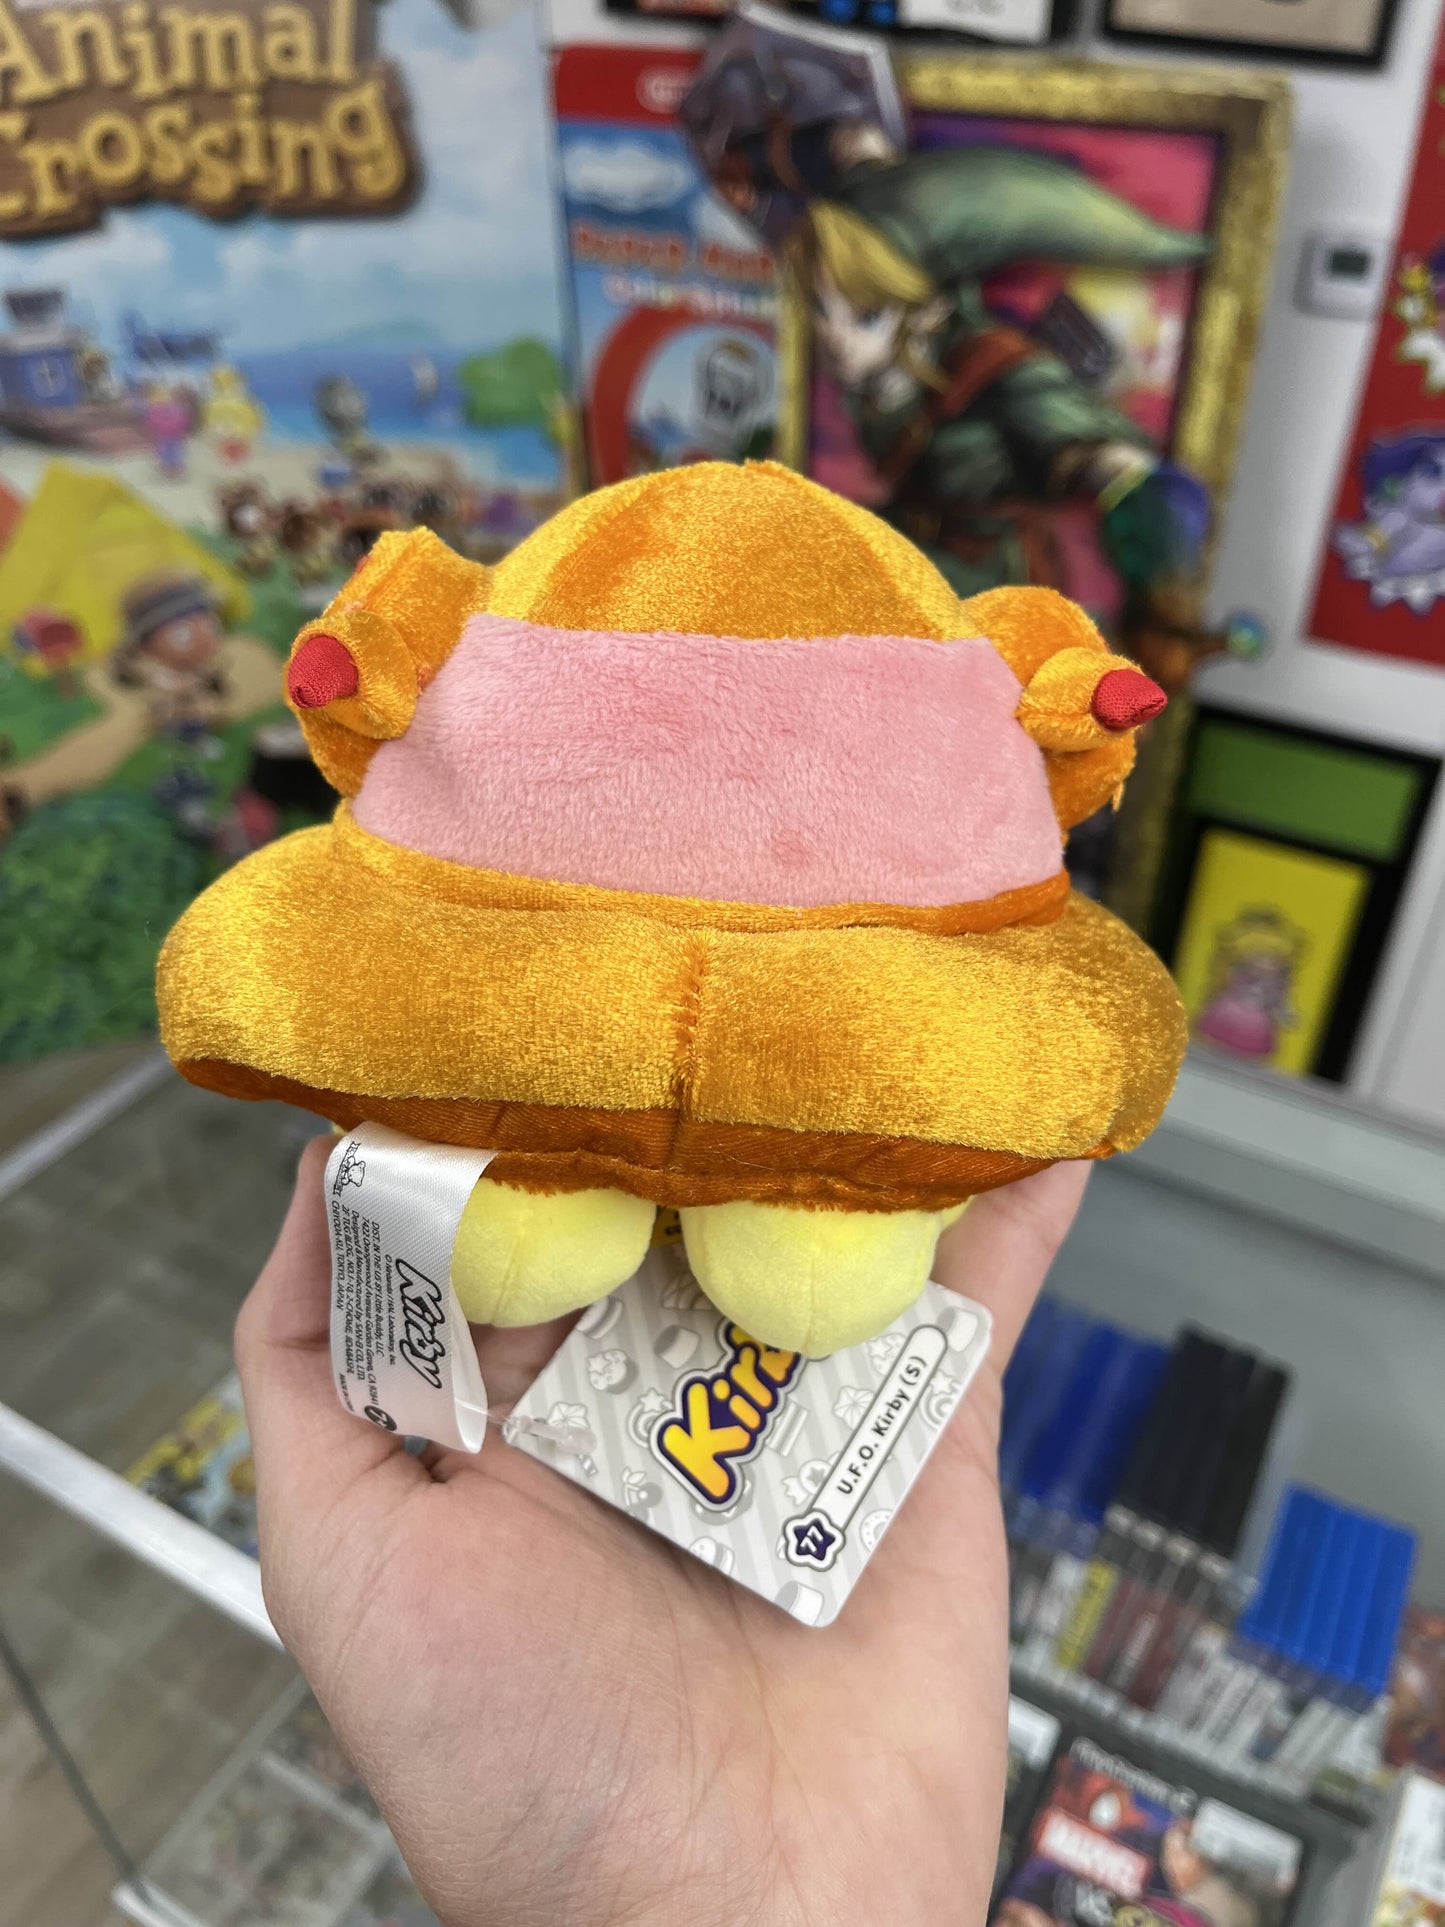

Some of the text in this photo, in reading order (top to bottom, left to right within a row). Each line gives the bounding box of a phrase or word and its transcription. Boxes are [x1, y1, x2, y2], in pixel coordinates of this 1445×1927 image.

[0, 0, 358, 98] Animal
[342, 1204, 351, 1216] 2F
[342, 1217, 351, 1233] TUG
[352, 1210, 362, 1248] Designed
[362, 1216, 371, 1237] 7422
[331, 1200, 345, 1311] CHIYODA-KU, TOKYO, JAPAN
[363, 1237, 373, 1290] Orangewood
[355, 1254, 364, 1312] Manufactured
[372, 1221, 385, 1357] DIST. IN THE US BY Little Buddy, LLC
[386, 1263, 394, 1294] Nintendo
[354, 1311, 363, 1321] by
[365, 1289, 374, 1319] Avenue
[387, 1300, 395, 1314] HAL
[355, 1321, 364, 1348] SAN-EI
[365, 1320, 374, 1348] Garden
[395, 1258, 446, 1389] Kirby
[368, 1373, 377, 1384] CA
[658, 1322, 800, 1501] Kir
[836, 1355, 928, 1495] U.F.O. Kirby (S)
